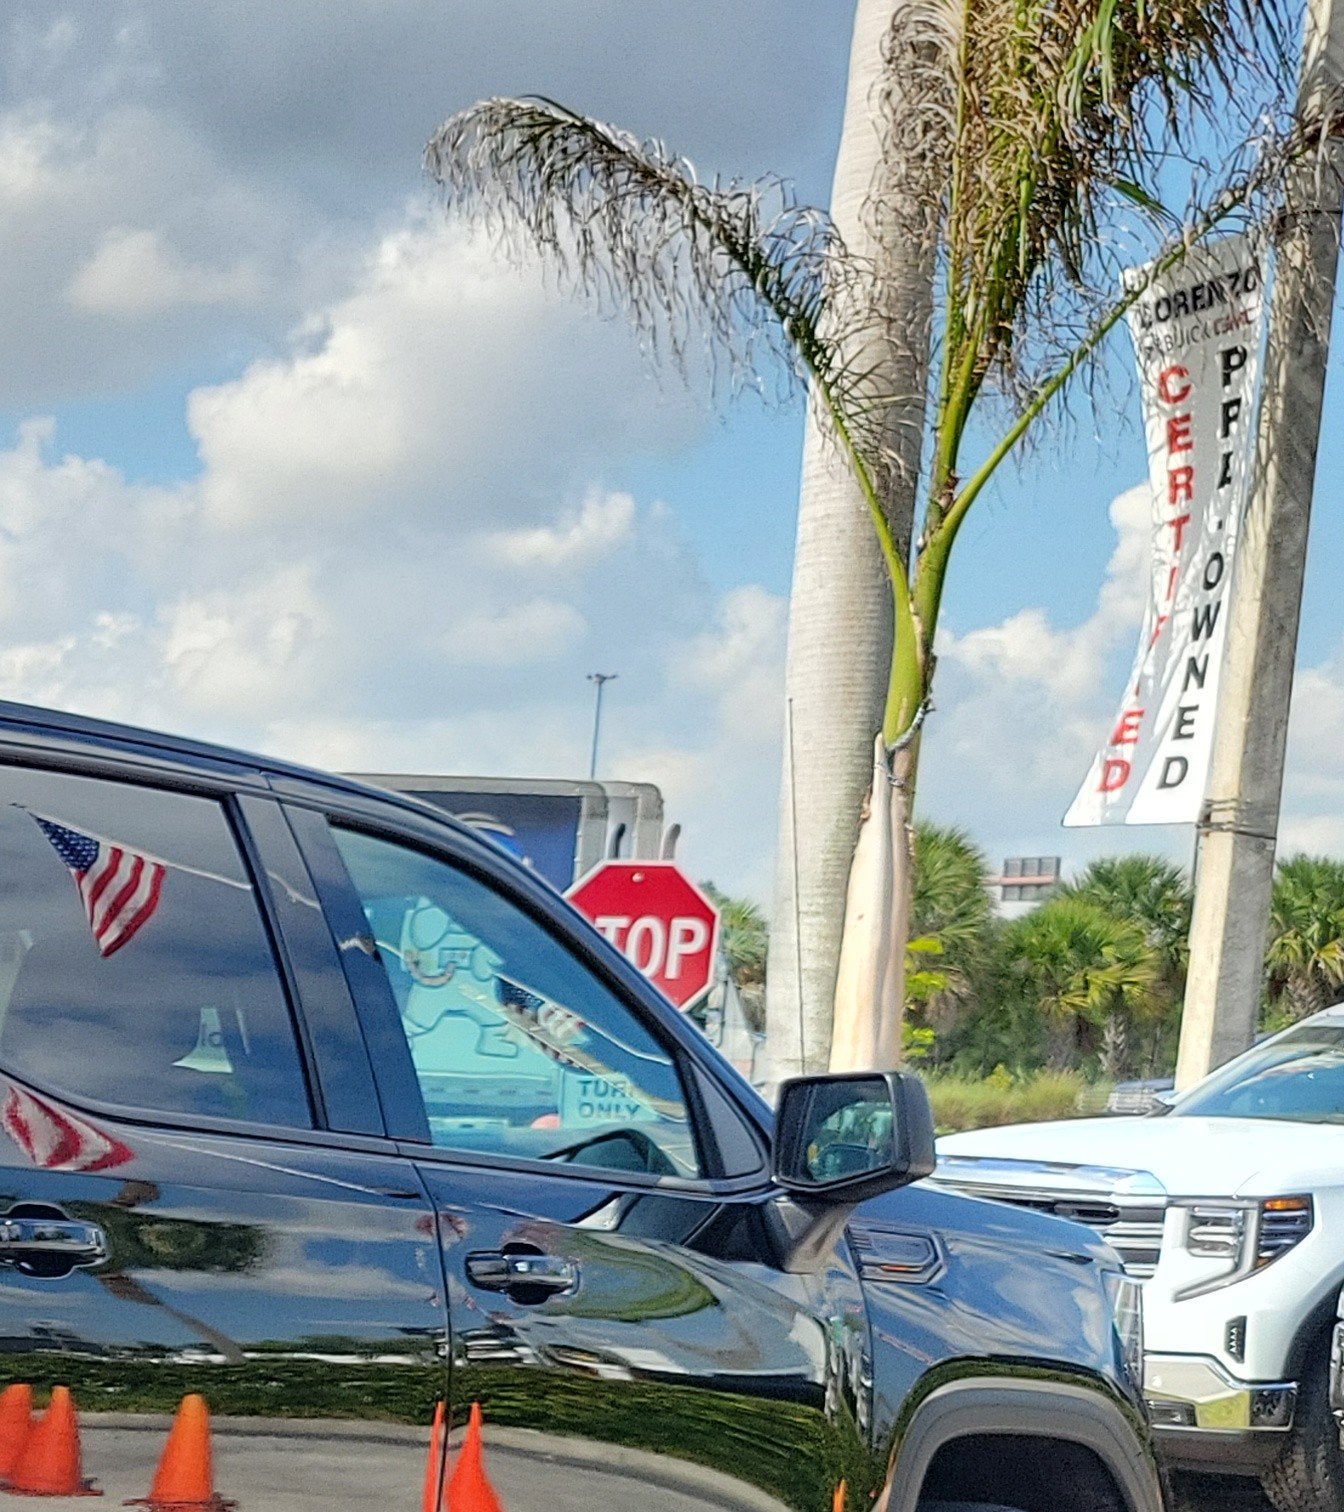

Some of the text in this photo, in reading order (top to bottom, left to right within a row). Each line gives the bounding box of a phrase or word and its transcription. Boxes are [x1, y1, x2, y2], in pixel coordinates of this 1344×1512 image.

[1139, 265, 1262, 329] LORENZO
[1164, 322, 1212, 352] BUICK
[1097, 364, 1194, 793] CERTIED
[593, 914, 709, 981] TOP
[577, 1080, 635, 1098] TUR
